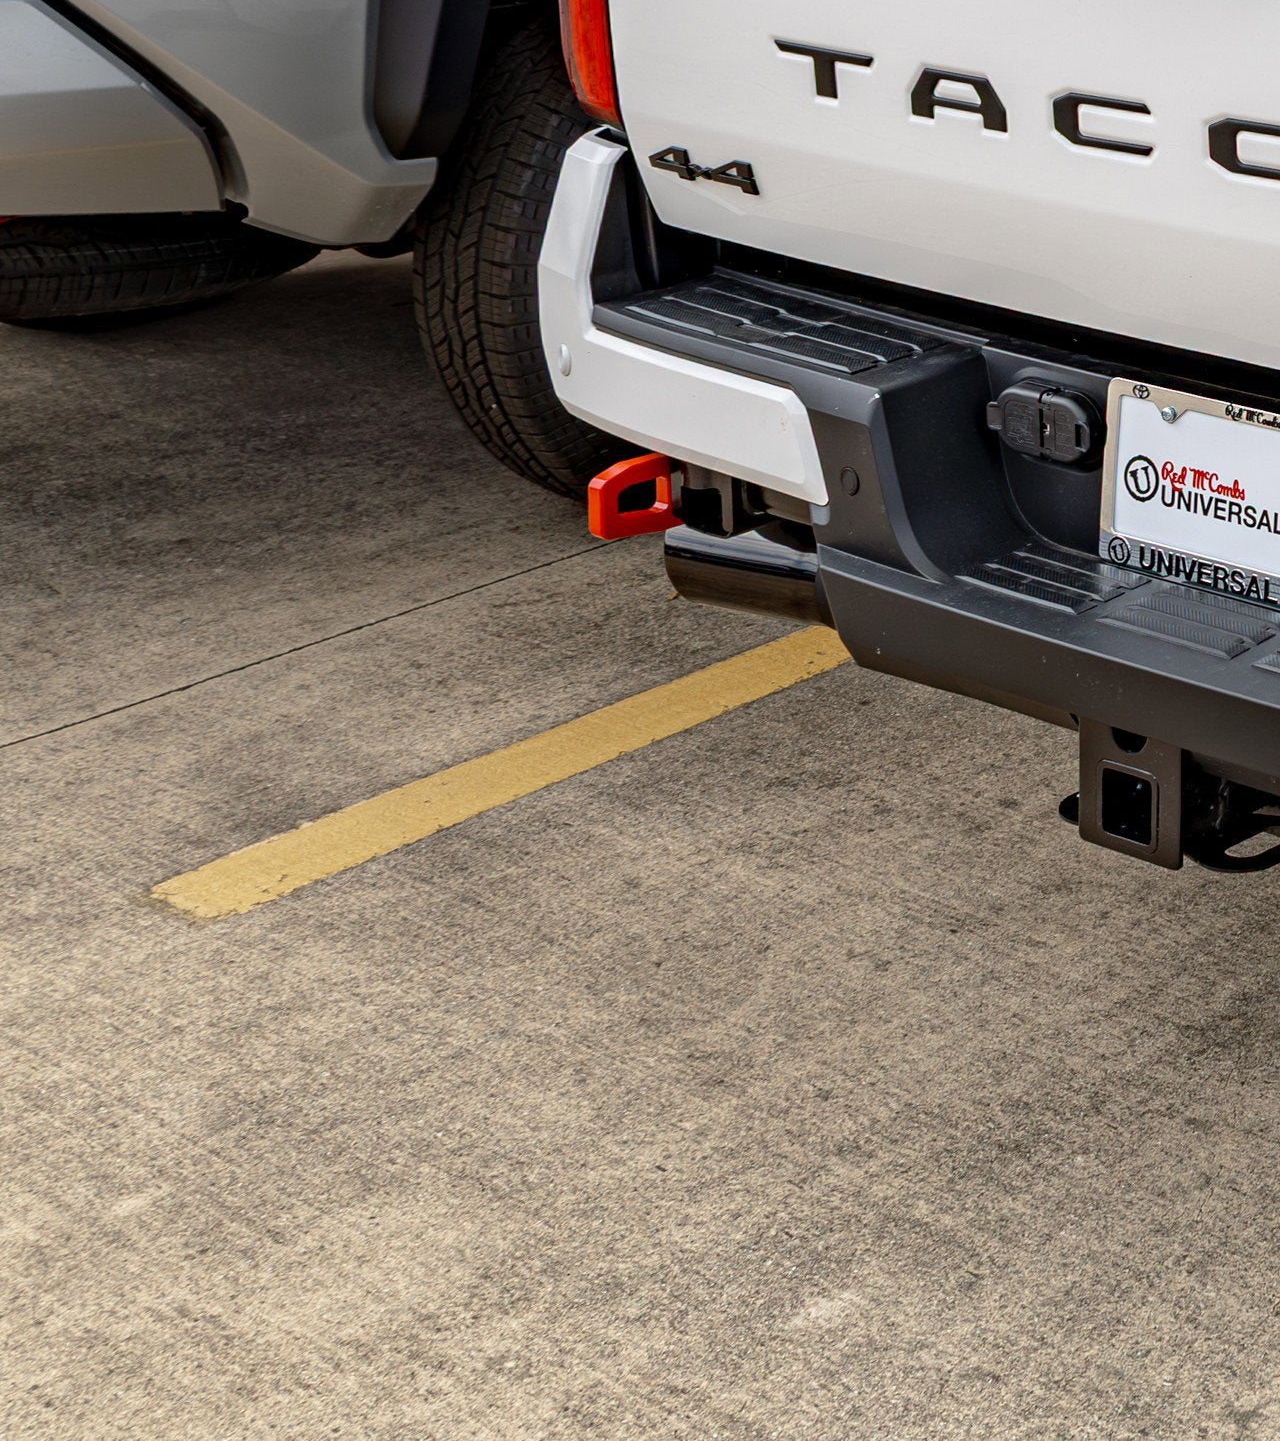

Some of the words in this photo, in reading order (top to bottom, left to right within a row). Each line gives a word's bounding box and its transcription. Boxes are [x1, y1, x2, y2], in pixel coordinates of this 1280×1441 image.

[1225, 404, 1243, 421] Red
[1161, 461, 1187, 491] Red
[1189, 468, 1246, 501] McCombs
[1138, 543, 1278, 605] UNIVERSAL
